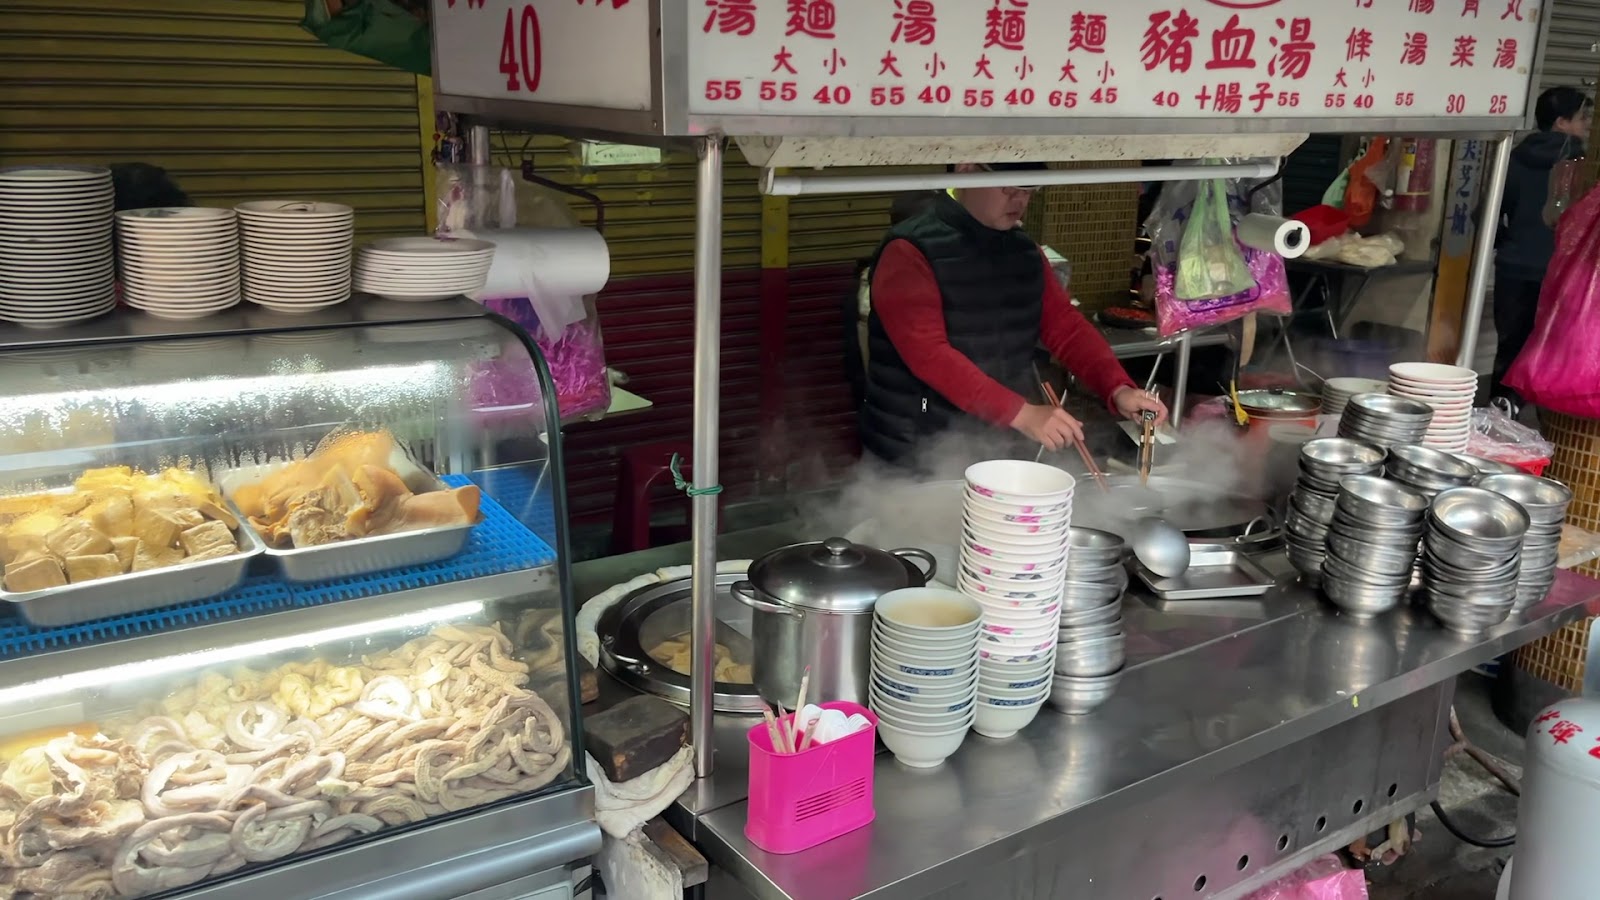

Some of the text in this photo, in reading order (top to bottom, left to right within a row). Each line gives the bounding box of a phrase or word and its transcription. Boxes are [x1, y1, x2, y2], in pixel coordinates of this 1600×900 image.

[703, 0, 757, 37] 湯
[785, 0, 836, 40] 麵
[889, 0, 938, 46] 湯
[982, 0, 1029, 52] 麵
[1067, 11, 1108, 55] 麵
[1139, 9, 1318, 81] 豬血湯
[499, 3, 543, 93] 40
[773, 46, 847, 76] 大 小
[880, 50, 947, 79] 大 小
[975, 54, 1035, 81] 大 小
[1060, 60, 1117, 84] 大 小
[705, 80, 743, 101] 55
[1334, 69, 1376, 89] 大 小
[758, 80, 853, 105] 55 40
[869, 85, 953, 106] 55 40
[963, 87, 1037, 108] 55 40
[1047, 86, 1119, 109] 65 45
[1152, 91, 1181, 108] 40
[1277, 91, 1301, 108] 55
[1324, 93, 1375, 109] 55 40
[1395, 92, 1415, 107] 55
[1446, 94, 1466, 113] 30
[1489, 95, 1508, 114] 25
